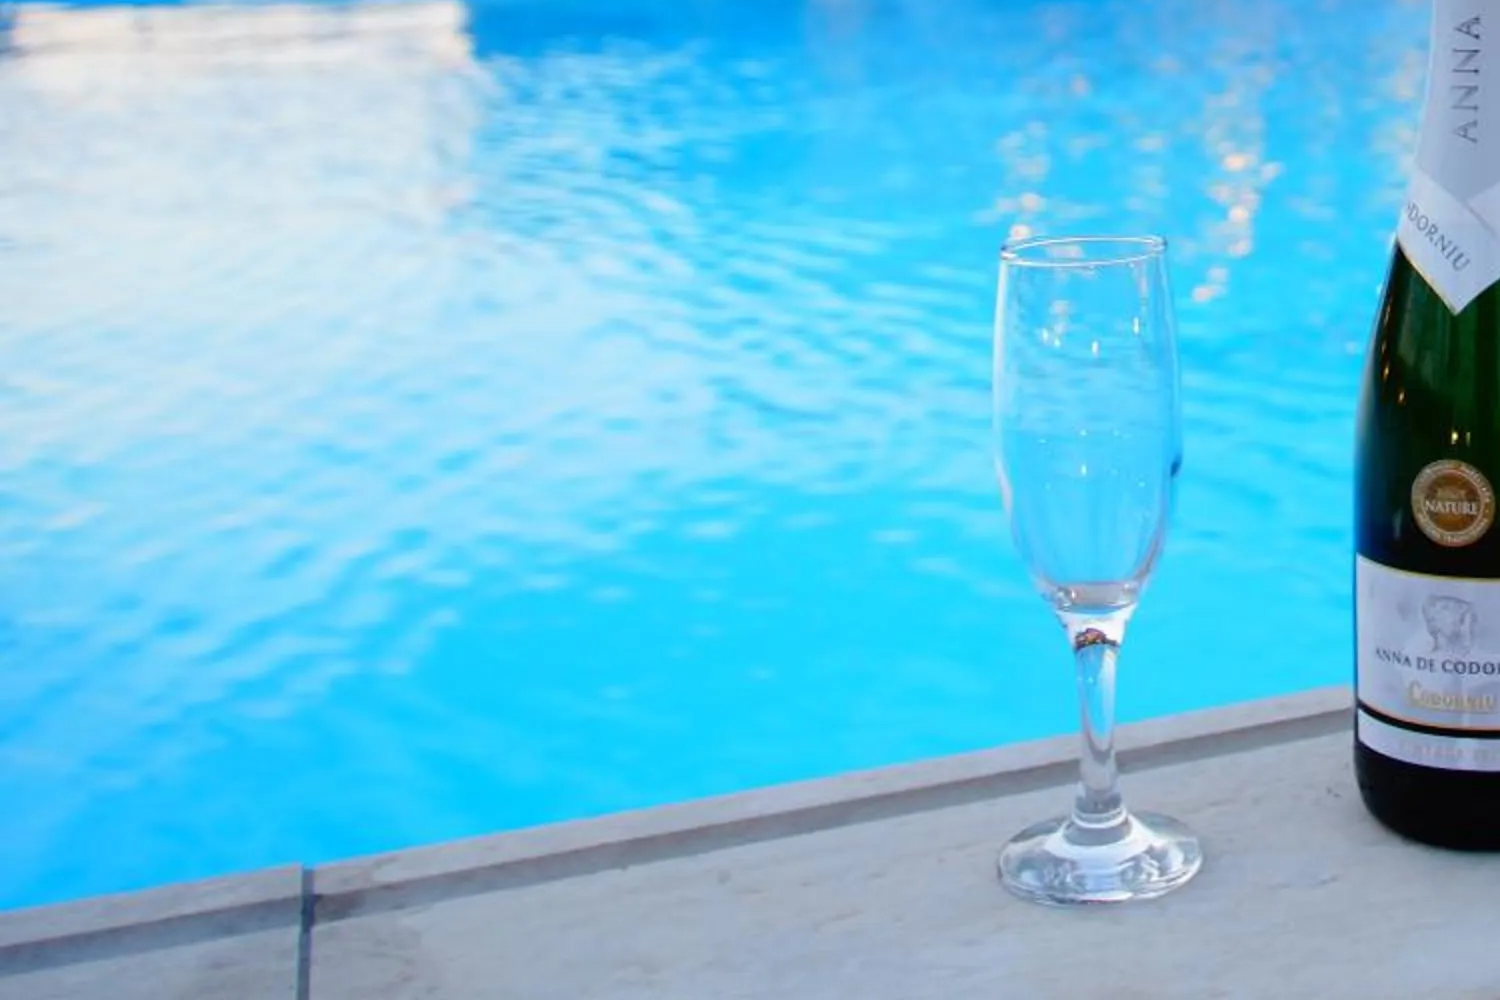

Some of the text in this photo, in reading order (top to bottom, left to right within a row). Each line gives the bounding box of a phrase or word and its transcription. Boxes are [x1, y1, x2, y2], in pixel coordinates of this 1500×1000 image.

[1451, 14, 1482, 144] ANNA
[1407, 202, 1471, 272] DORNIU
[1424, 499, 1479, 516] NATURE
[1375, 647, 1412, 669] ANNA
[1416, 656, 1436, 673] DE
